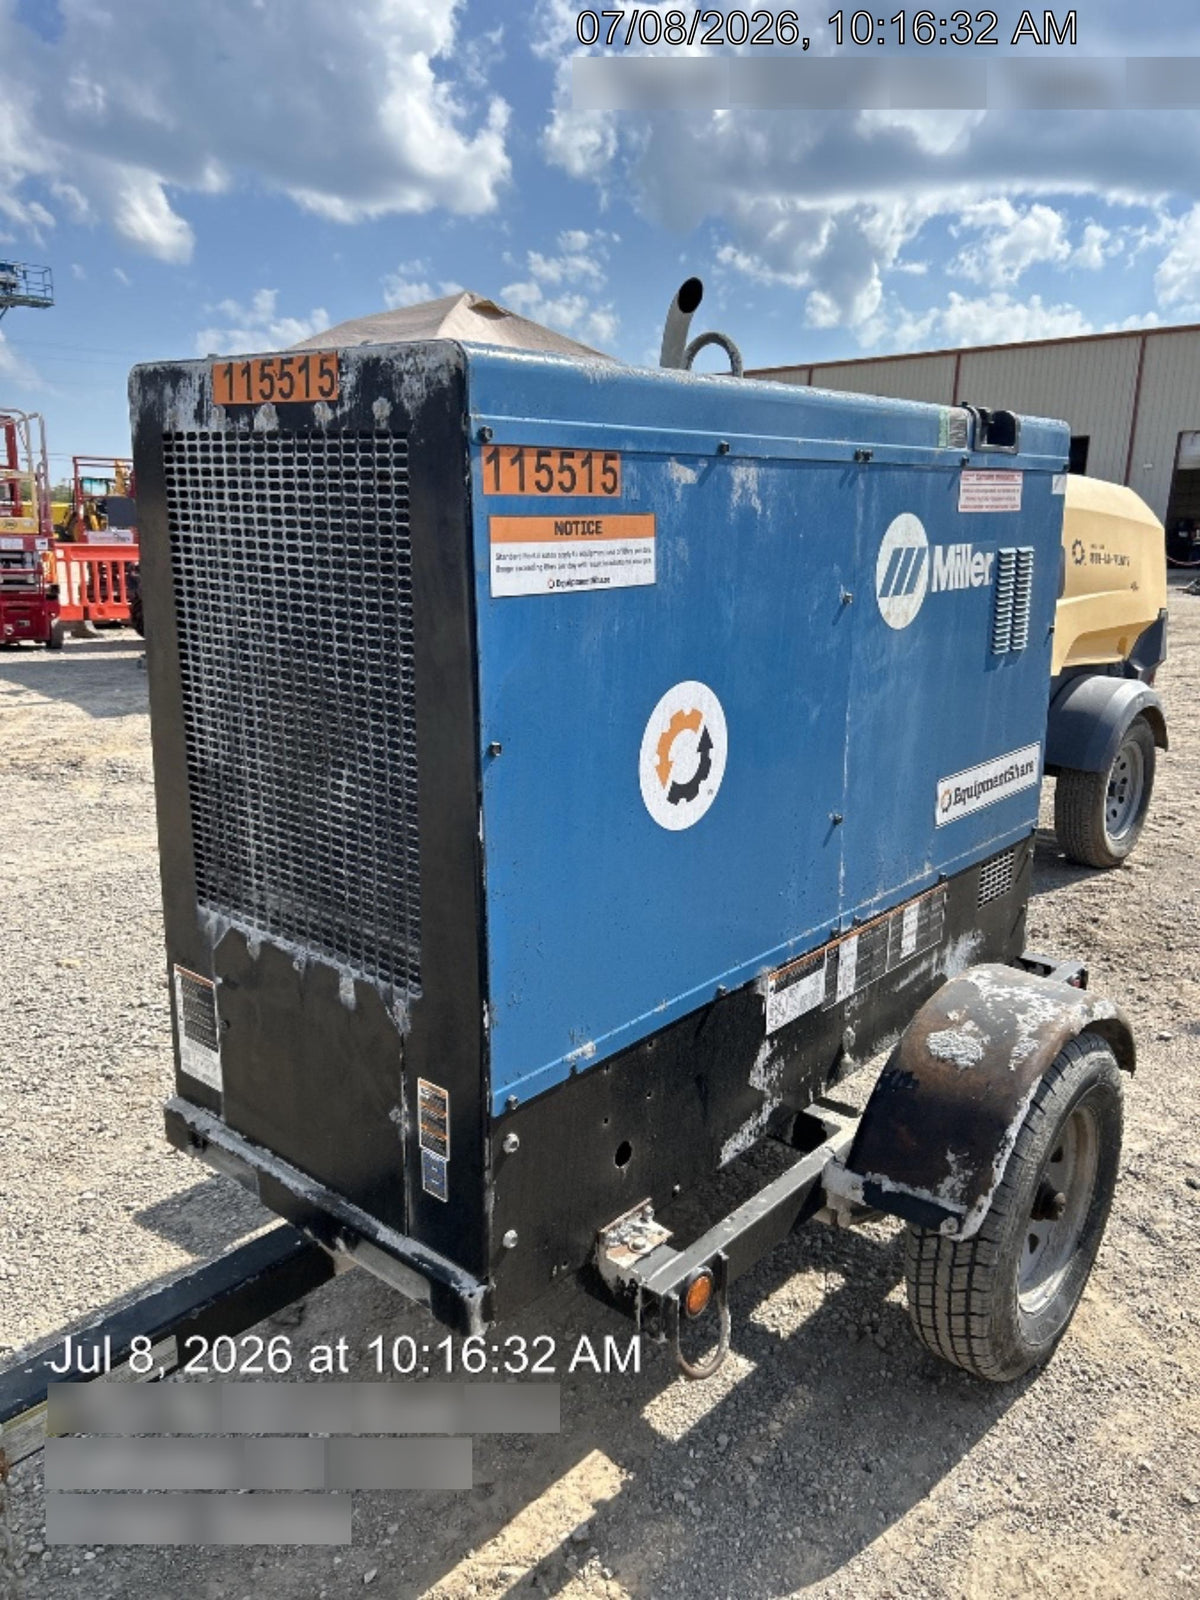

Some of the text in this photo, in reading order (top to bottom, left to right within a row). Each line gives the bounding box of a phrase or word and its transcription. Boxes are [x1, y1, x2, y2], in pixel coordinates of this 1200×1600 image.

[223, 355, 335, 401] 115515
[485, 447, 618, 494] 115515
[554, 520, 603, 536] NOTICE
[931, 543, 994, 592] Miller
